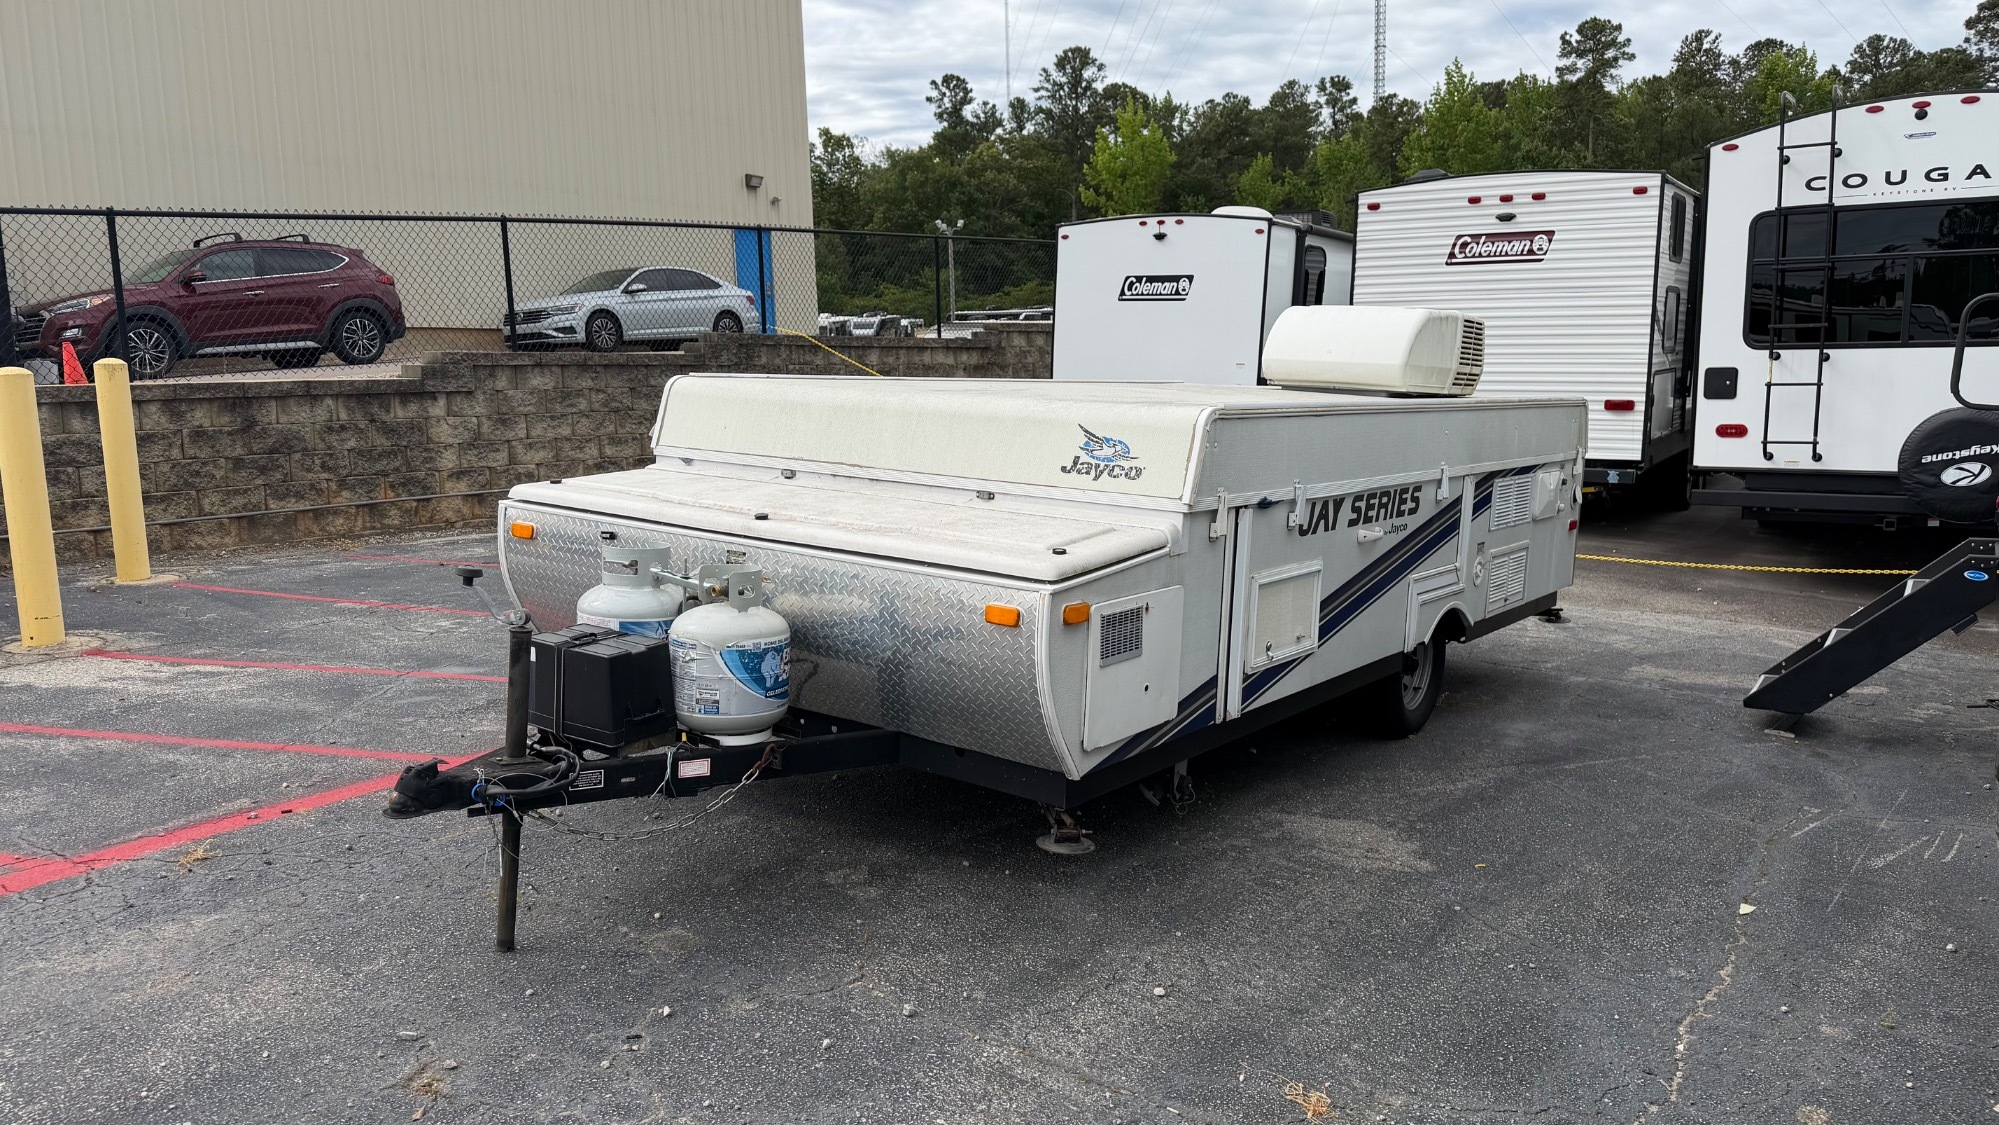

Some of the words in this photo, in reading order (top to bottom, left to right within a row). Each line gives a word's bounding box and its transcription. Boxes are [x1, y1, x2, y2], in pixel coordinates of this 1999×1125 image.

[1873, 188, 1934, 196] KEYSTONE
[1454, 235, 1531, 259] Coleman
[1124, 276, 1178, 296] Coleman
[1060, 455, 1143, 481] Jayco
[1298, 496, 1346, 537] JAY
[1347, 485, 1423, 528] SERIES
[1388, 522, 1408, 535] Jayco
